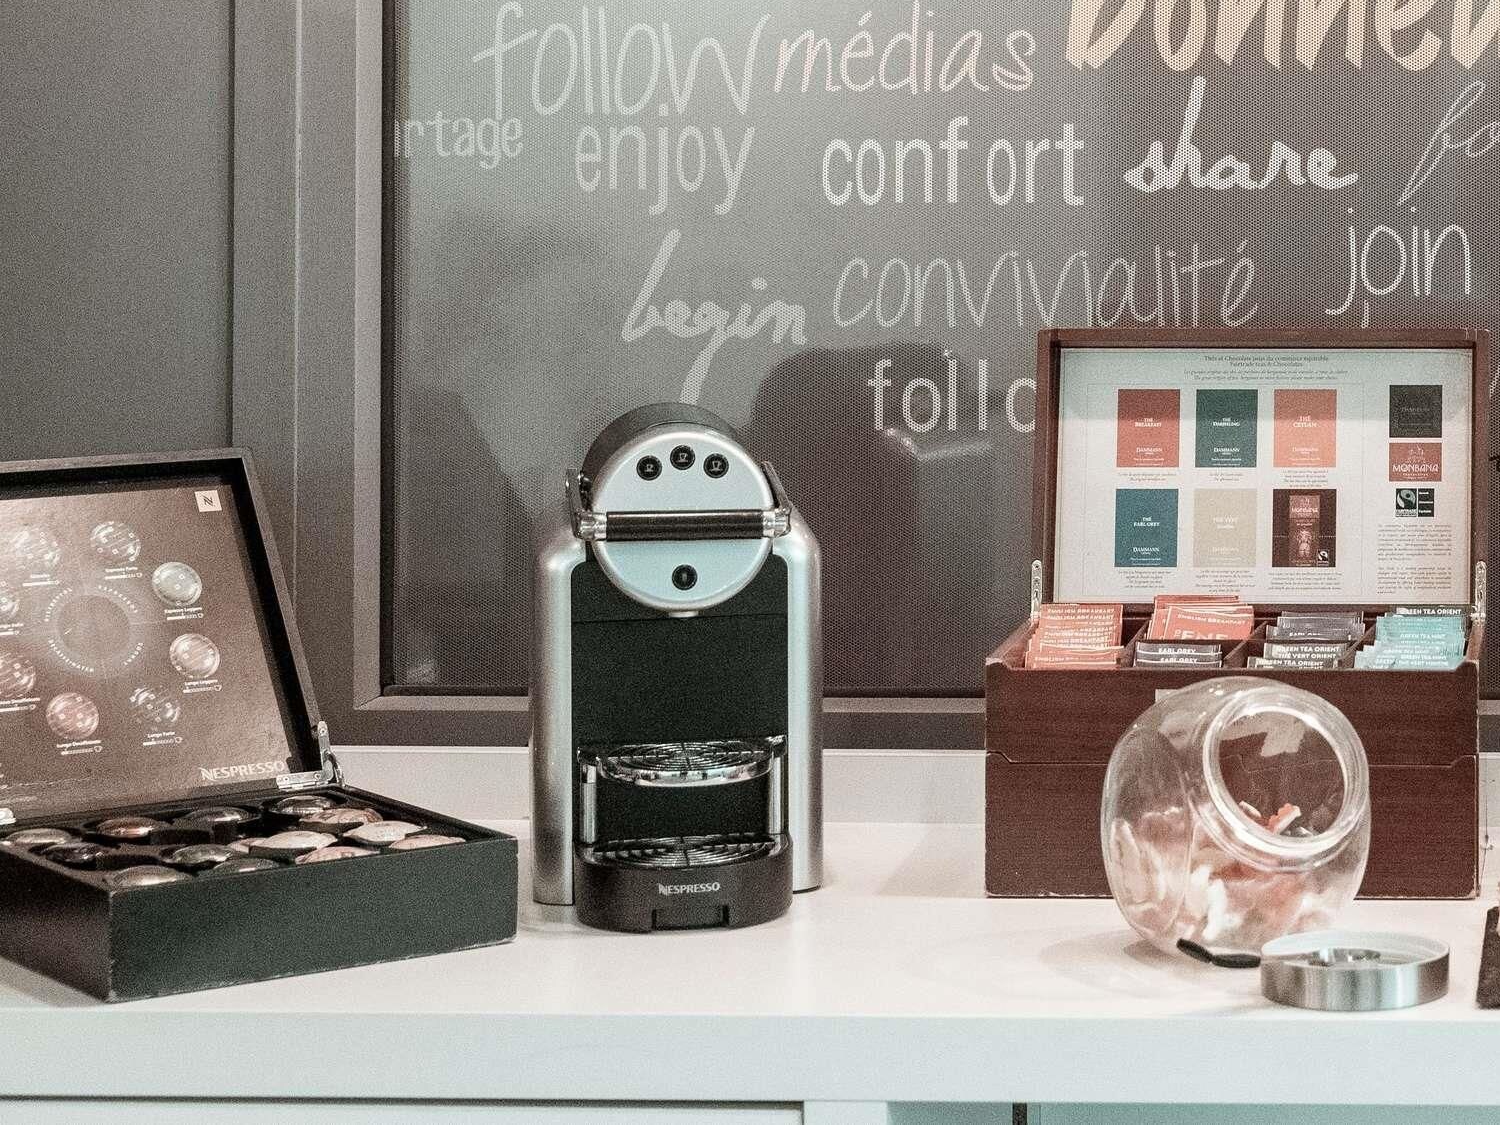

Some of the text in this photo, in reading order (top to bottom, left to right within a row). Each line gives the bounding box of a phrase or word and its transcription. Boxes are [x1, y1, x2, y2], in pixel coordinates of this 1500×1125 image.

[473, 1, 773, 119] follow
[775, 0, 1036, 95] médias
[575, 109, 755, 216] enjoy
[822, 117, 1085, 206] confort
[1123, 75, 1359, 194] share
[832, 236, 1259, 329] convivialité
[1325, 205, 1471, 317] join
[620, 228, 808, 404] begin
[1392, 463, 1439, 472] MONBANA
[200, 760, 285, 782] NESPRESSO
[657, 881, 721, 896] NESPRESSO
